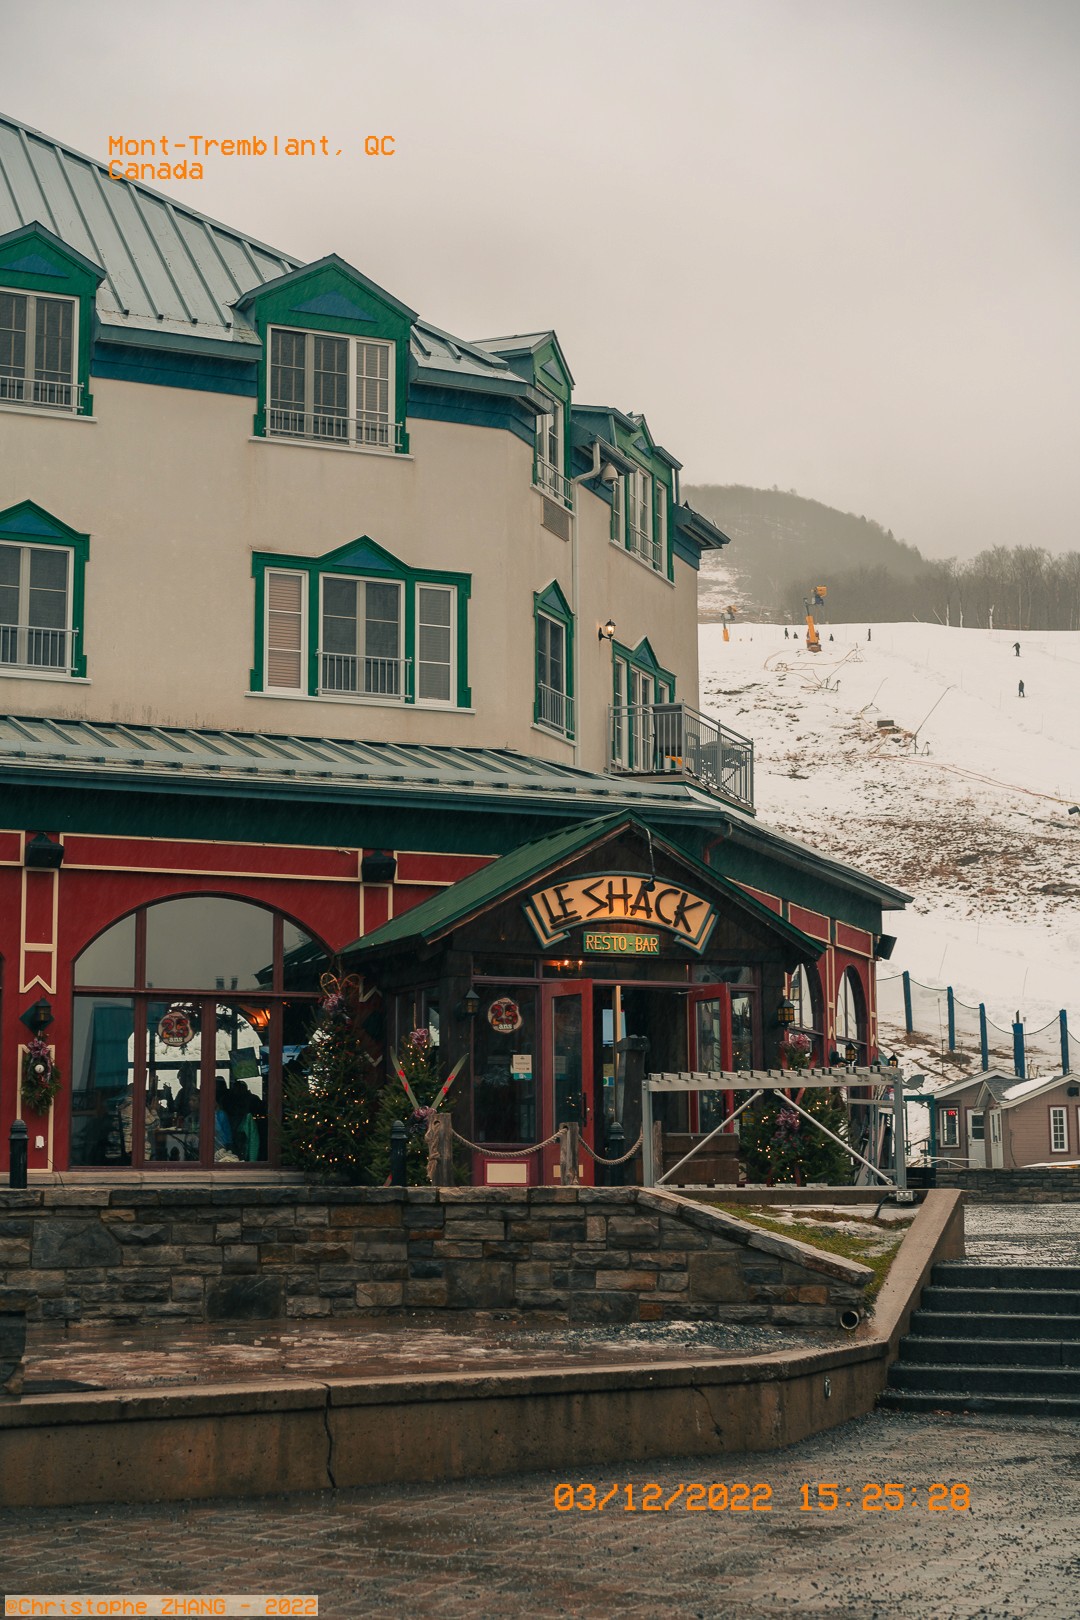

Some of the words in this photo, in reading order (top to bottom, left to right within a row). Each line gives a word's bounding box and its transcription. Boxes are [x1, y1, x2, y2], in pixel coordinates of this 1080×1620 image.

[541, 884, 580, 927] LE
[582, 877, 704, 932] SHACK
[491, 1004, 519, 1025] 25
[162, 1019, 189, 1039] 25
